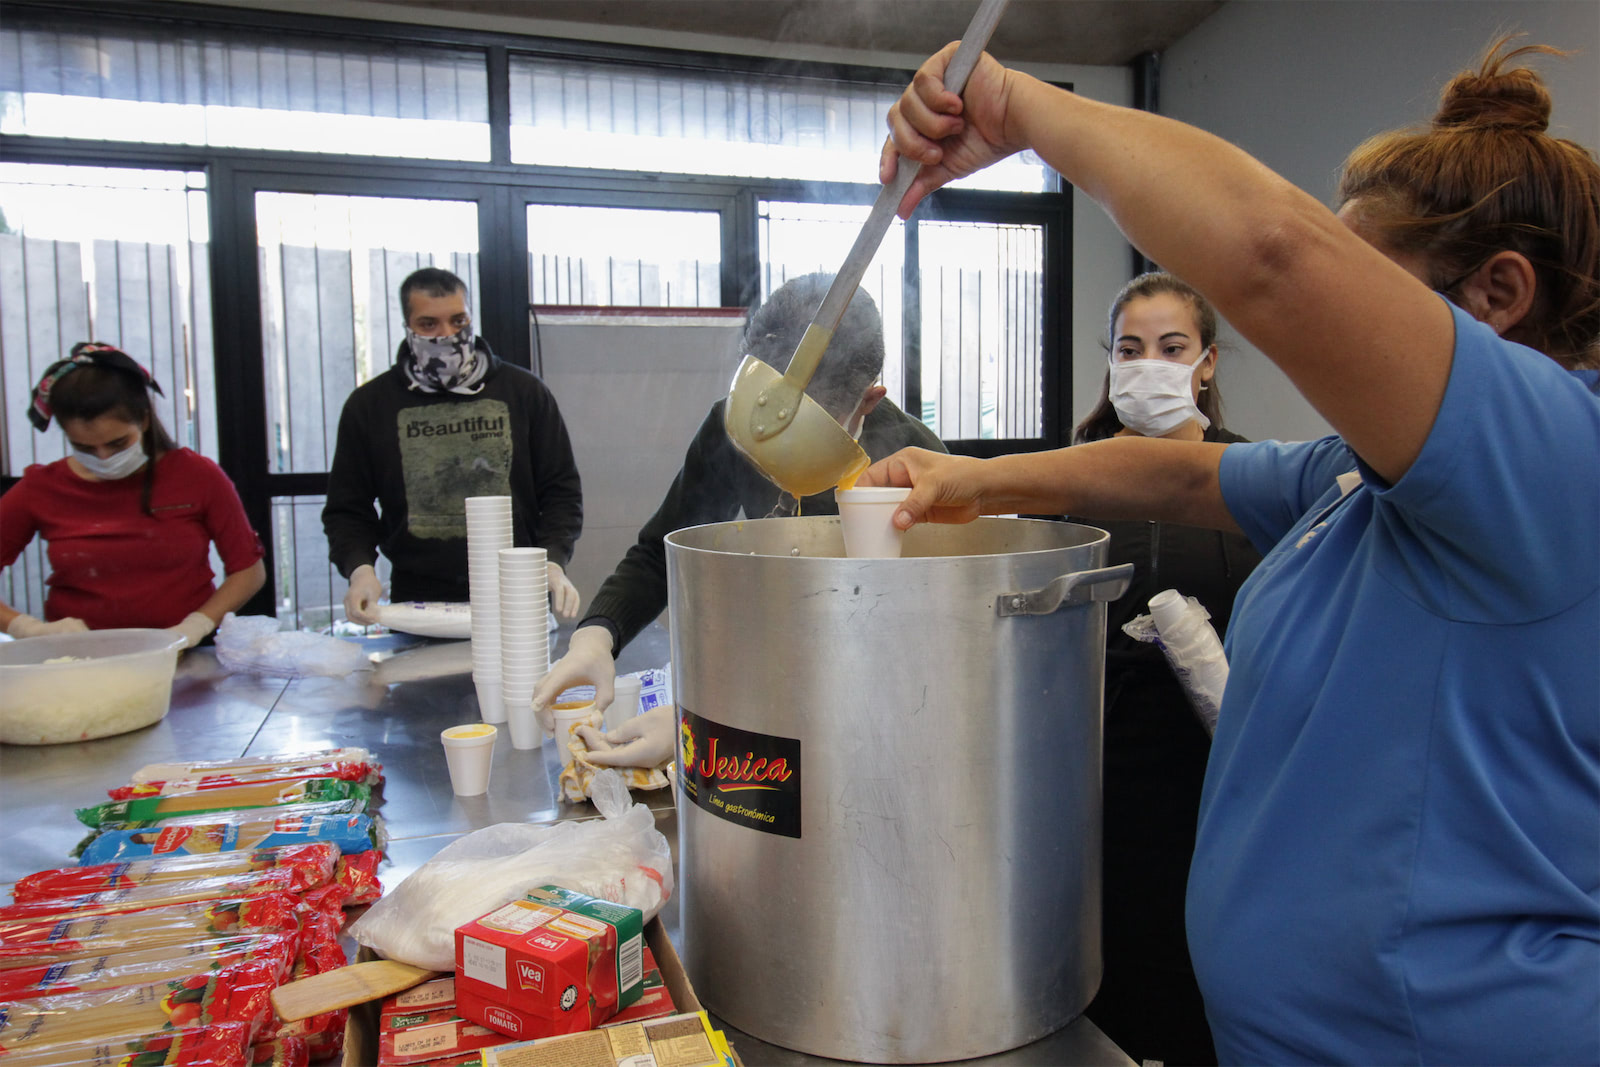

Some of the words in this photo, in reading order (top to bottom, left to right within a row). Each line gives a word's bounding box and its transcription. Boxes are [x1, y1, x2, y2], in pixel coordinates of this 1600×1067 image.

[407, 416, 503, 438] beautiful
[471, 431, 504, 441] game
[699, 738, 793, 782] Jesica
[725, 803, 775, 823] gastronómica
[521, 965, 542, 982] Vea
[489, 1015, 518, 1032] TOMATES
